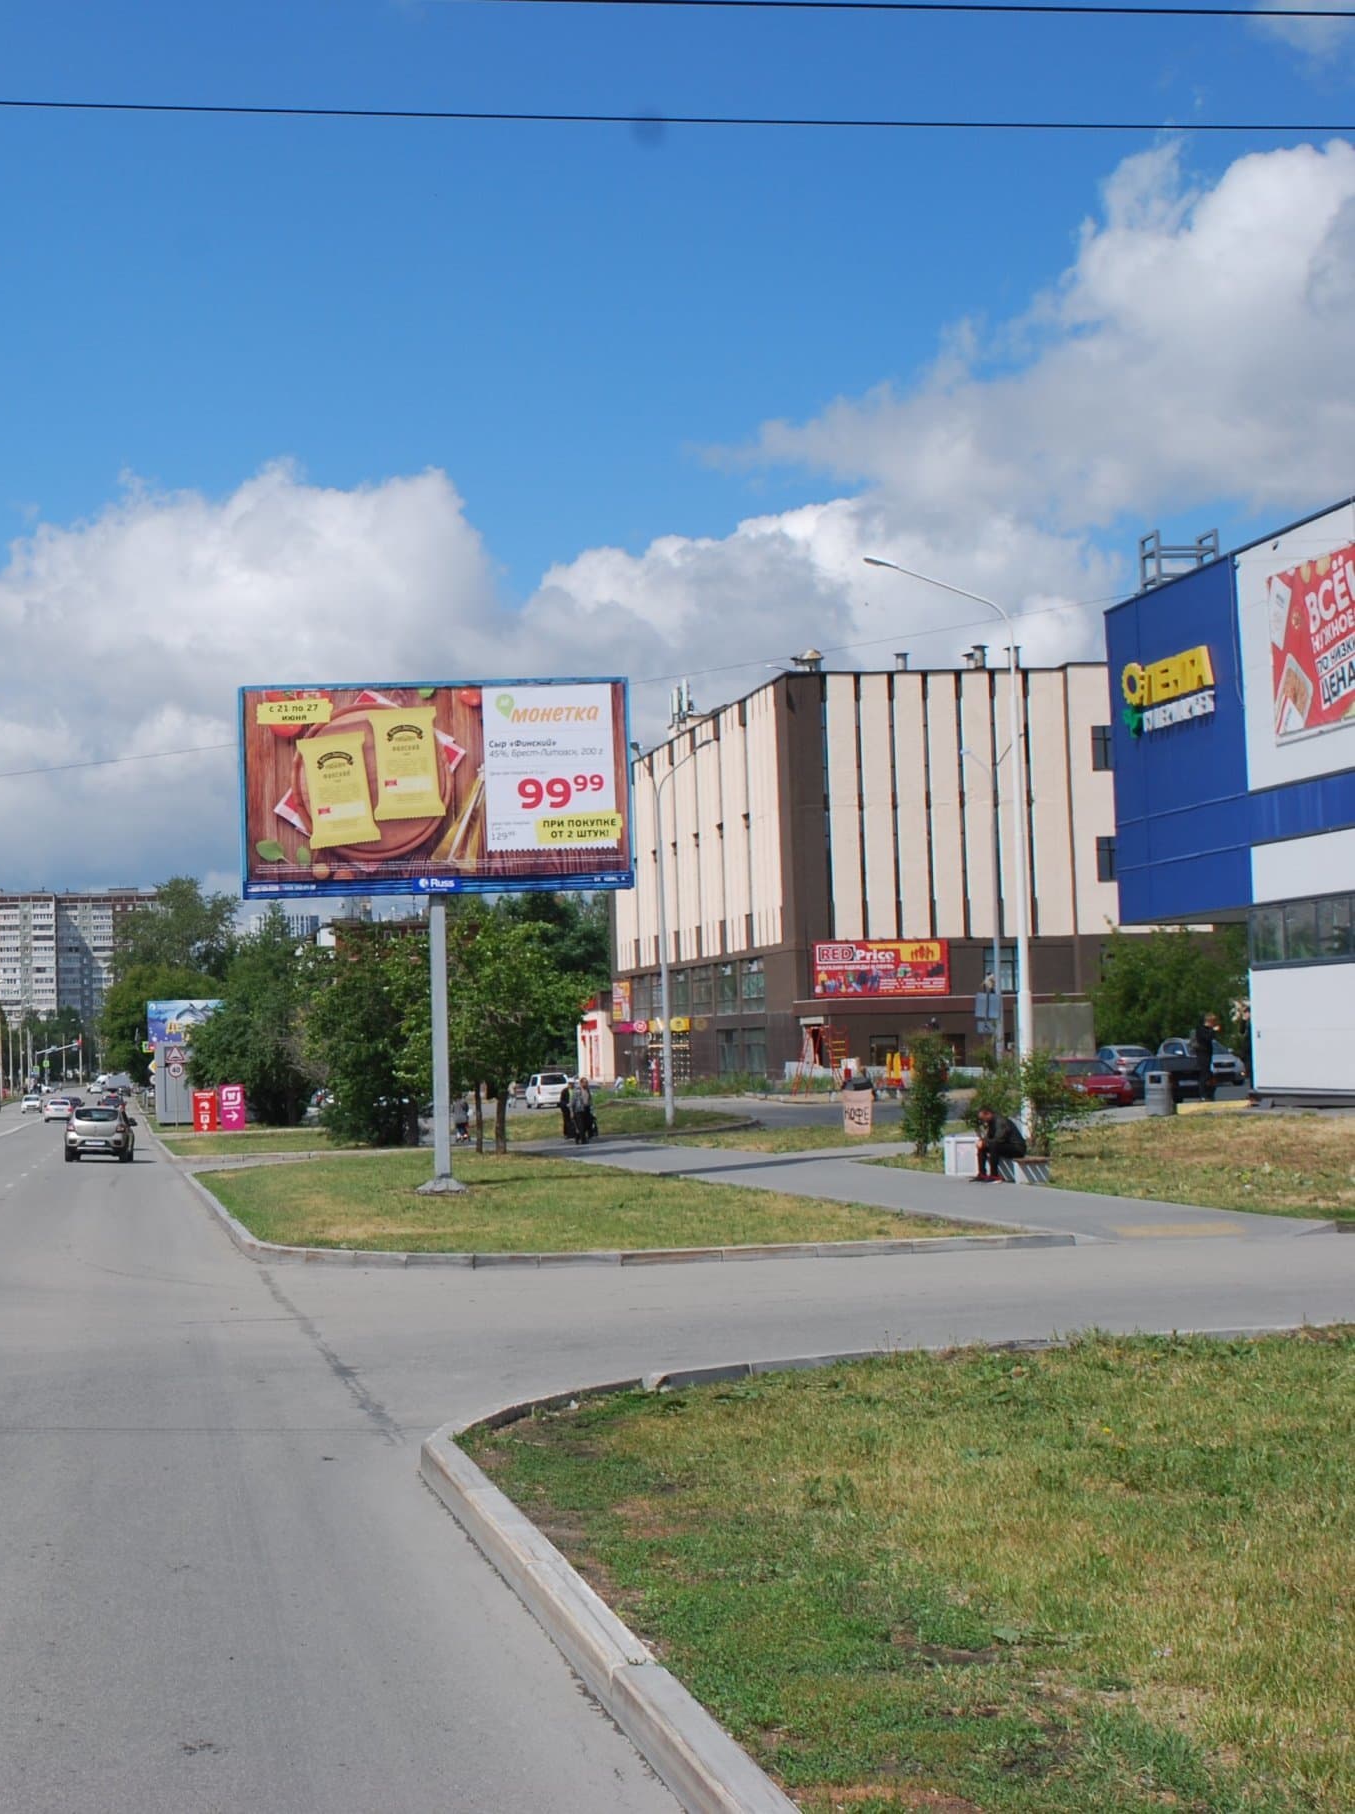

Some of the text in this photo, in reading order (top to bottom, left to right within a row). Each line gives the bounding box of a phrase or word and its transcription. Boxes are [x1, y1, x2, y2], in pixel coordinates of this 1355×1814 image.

[277, 704, 289, 713] 21
[292, 704, 305, 712] по
[306, 704, 319, 712] 27
[488, 740, 507, 749] Сыр
[542, 818, 617, 828] ПРИ ПОКУПКЕ
[550, 829, 610, 839] ОТ 2 ШТУК!
[430, 878, 456, 888] Russ
[820, 947, 854, 960] RED
